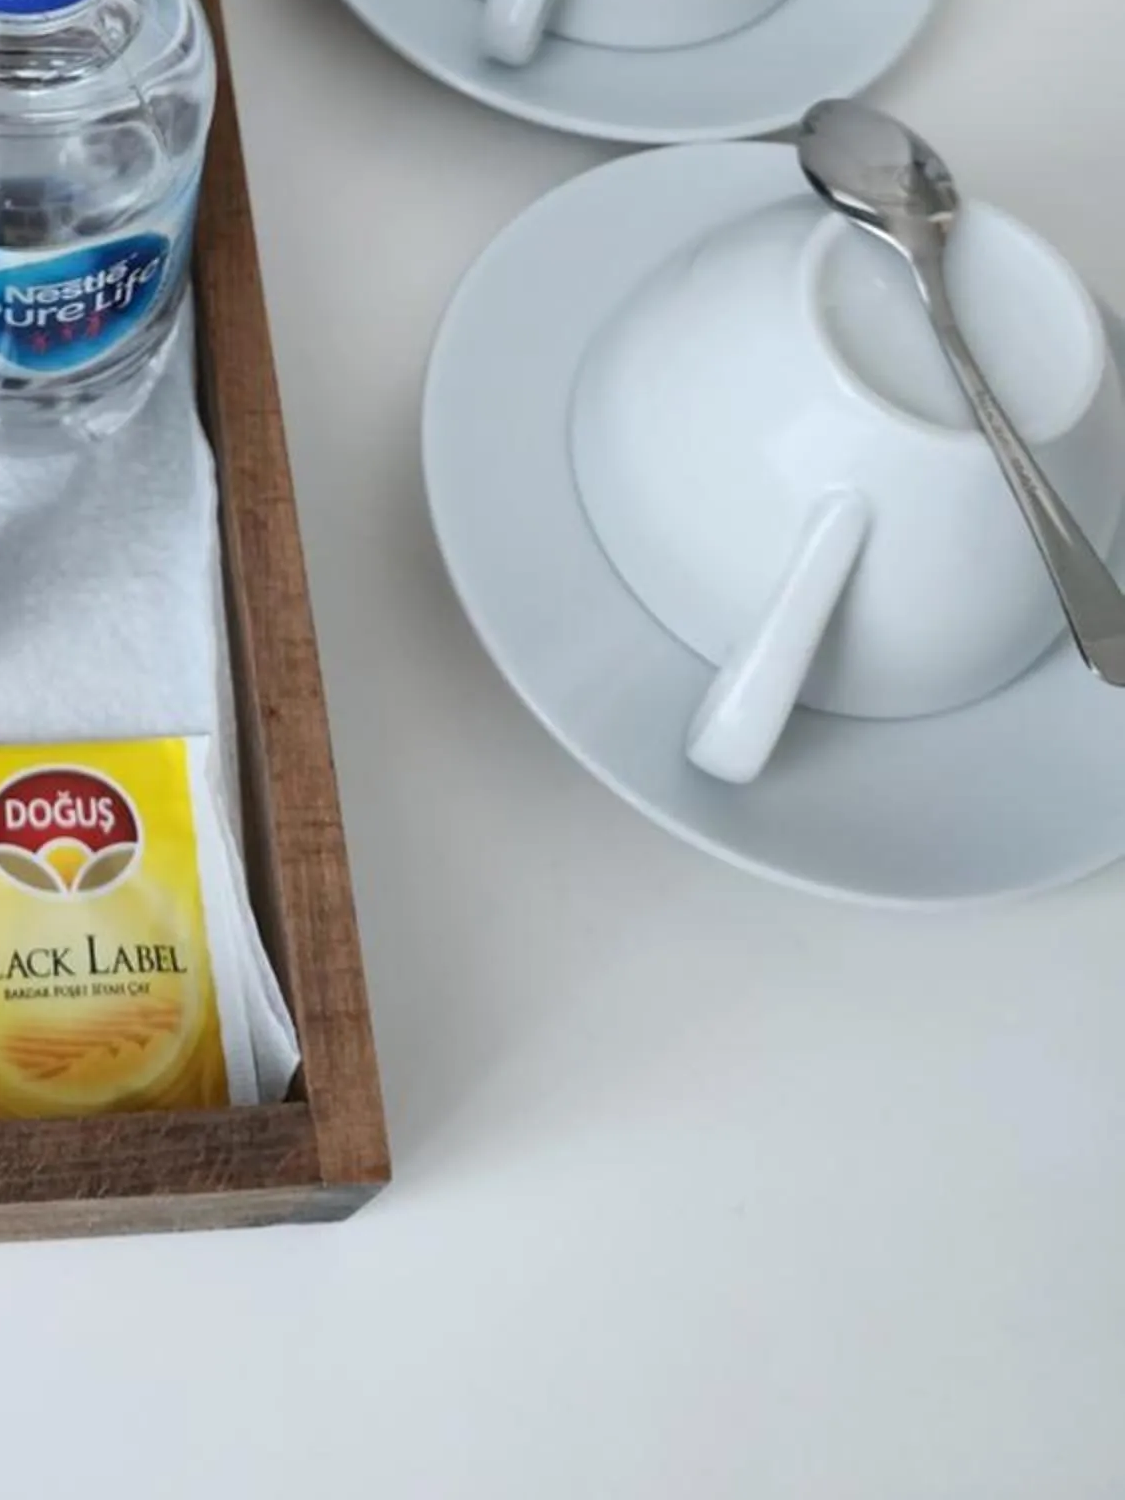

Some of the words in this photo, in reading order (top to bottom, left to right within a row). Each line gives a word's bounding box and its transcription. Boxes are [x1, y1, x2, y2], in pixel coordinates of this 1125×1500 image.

[95, 257, 160, 312] Life
[5, 789, 116, 834] DOĞUŞ
[86, 934, 188, 976] LABEL
